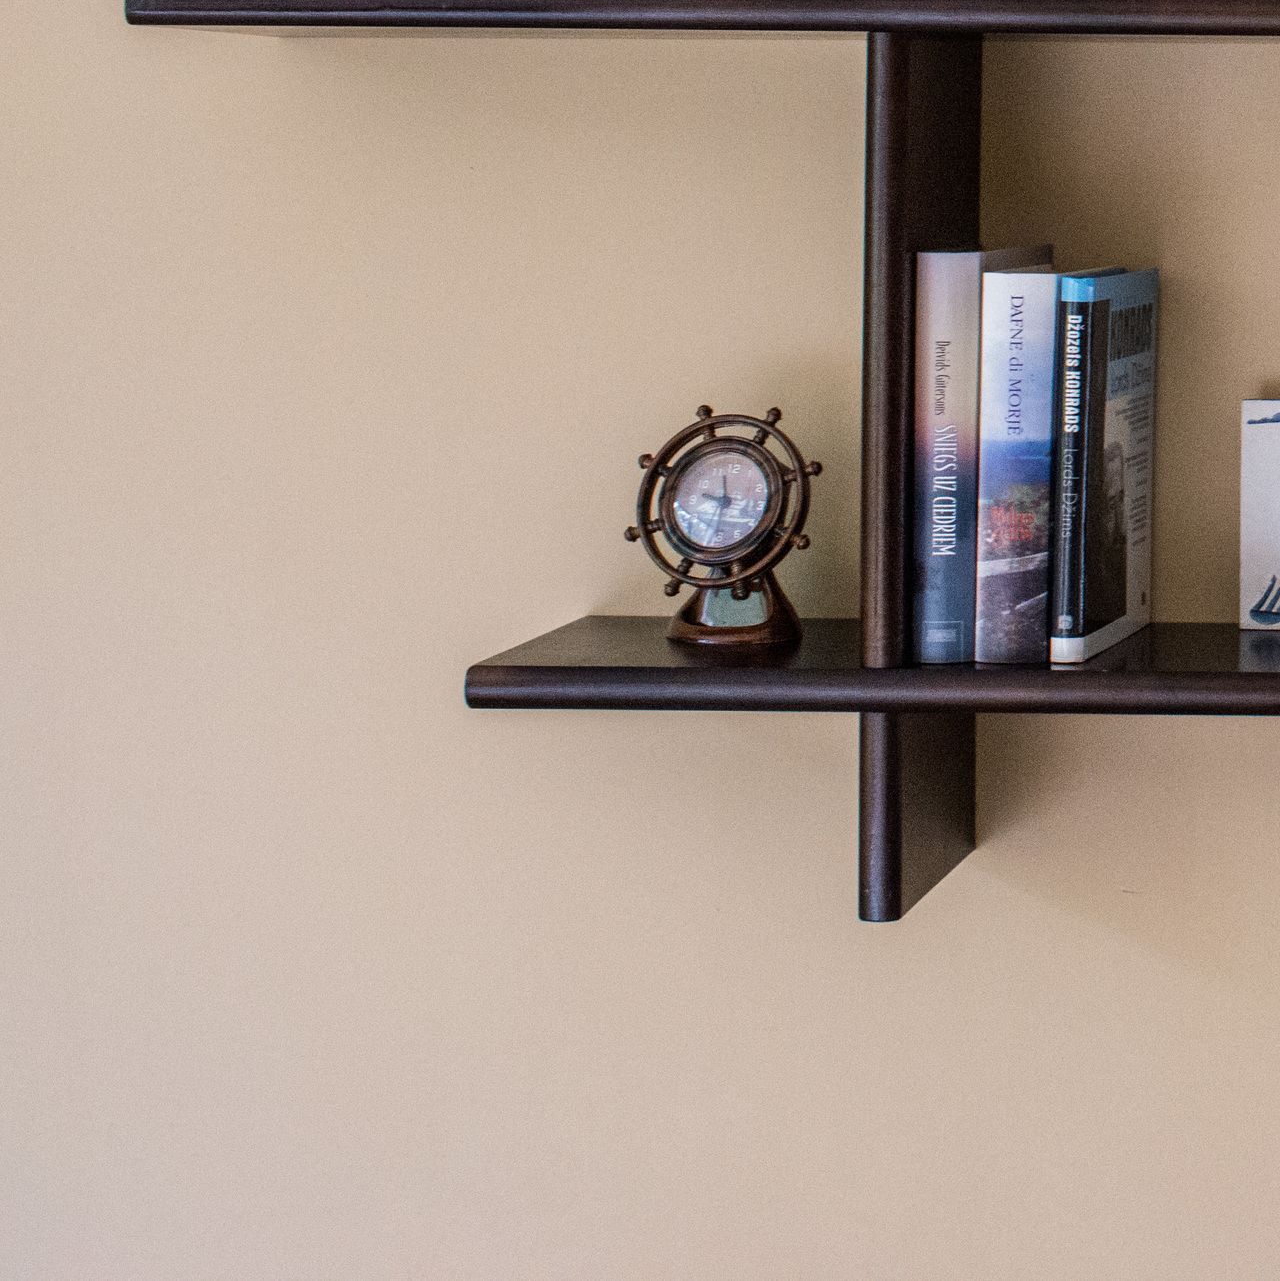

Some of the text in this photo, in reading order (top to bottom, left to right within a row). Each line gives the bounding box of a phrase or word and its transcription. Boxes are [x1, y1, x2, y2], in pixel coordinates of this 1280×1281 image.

[1009, 294, 1024, 351] DAFNE
[934, 340, 951, 371] Deivids
[1009, 356, 1024, 371] di
[1064, 315, 1083, 433] Džozefs KONRADS
[728, 463, 741, 474] 12
[932, 424, 957, 556] SNIEGS UZ CIEDRIEM
[1061, 448, 1079, 538] Lords Džims
